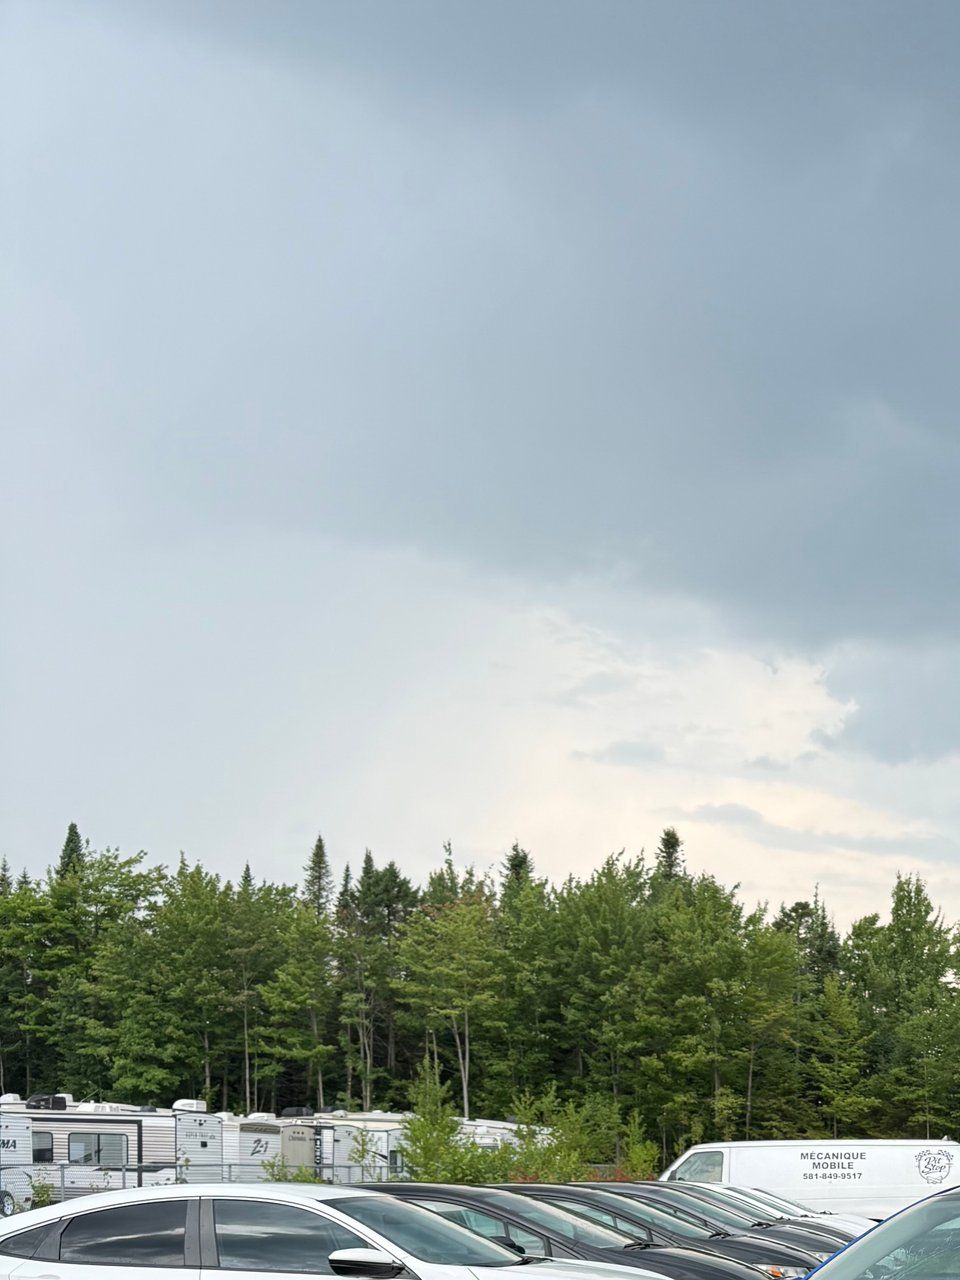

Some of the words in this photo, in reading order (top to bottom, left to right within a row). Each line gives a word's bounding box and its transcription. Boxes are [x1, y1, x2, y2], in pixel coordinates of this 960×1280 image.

[0, 1139, 17, 1149] MA
[800, 1150, 867, 1160] MÉCANIQUE
[812, 1161, 854, 1170] MOBILE
[924, 1156, 942, 1166] Pit
[921, 1164, 947, 1175] Stop
[803, 1172, 862, 1180] 581-849-9517
